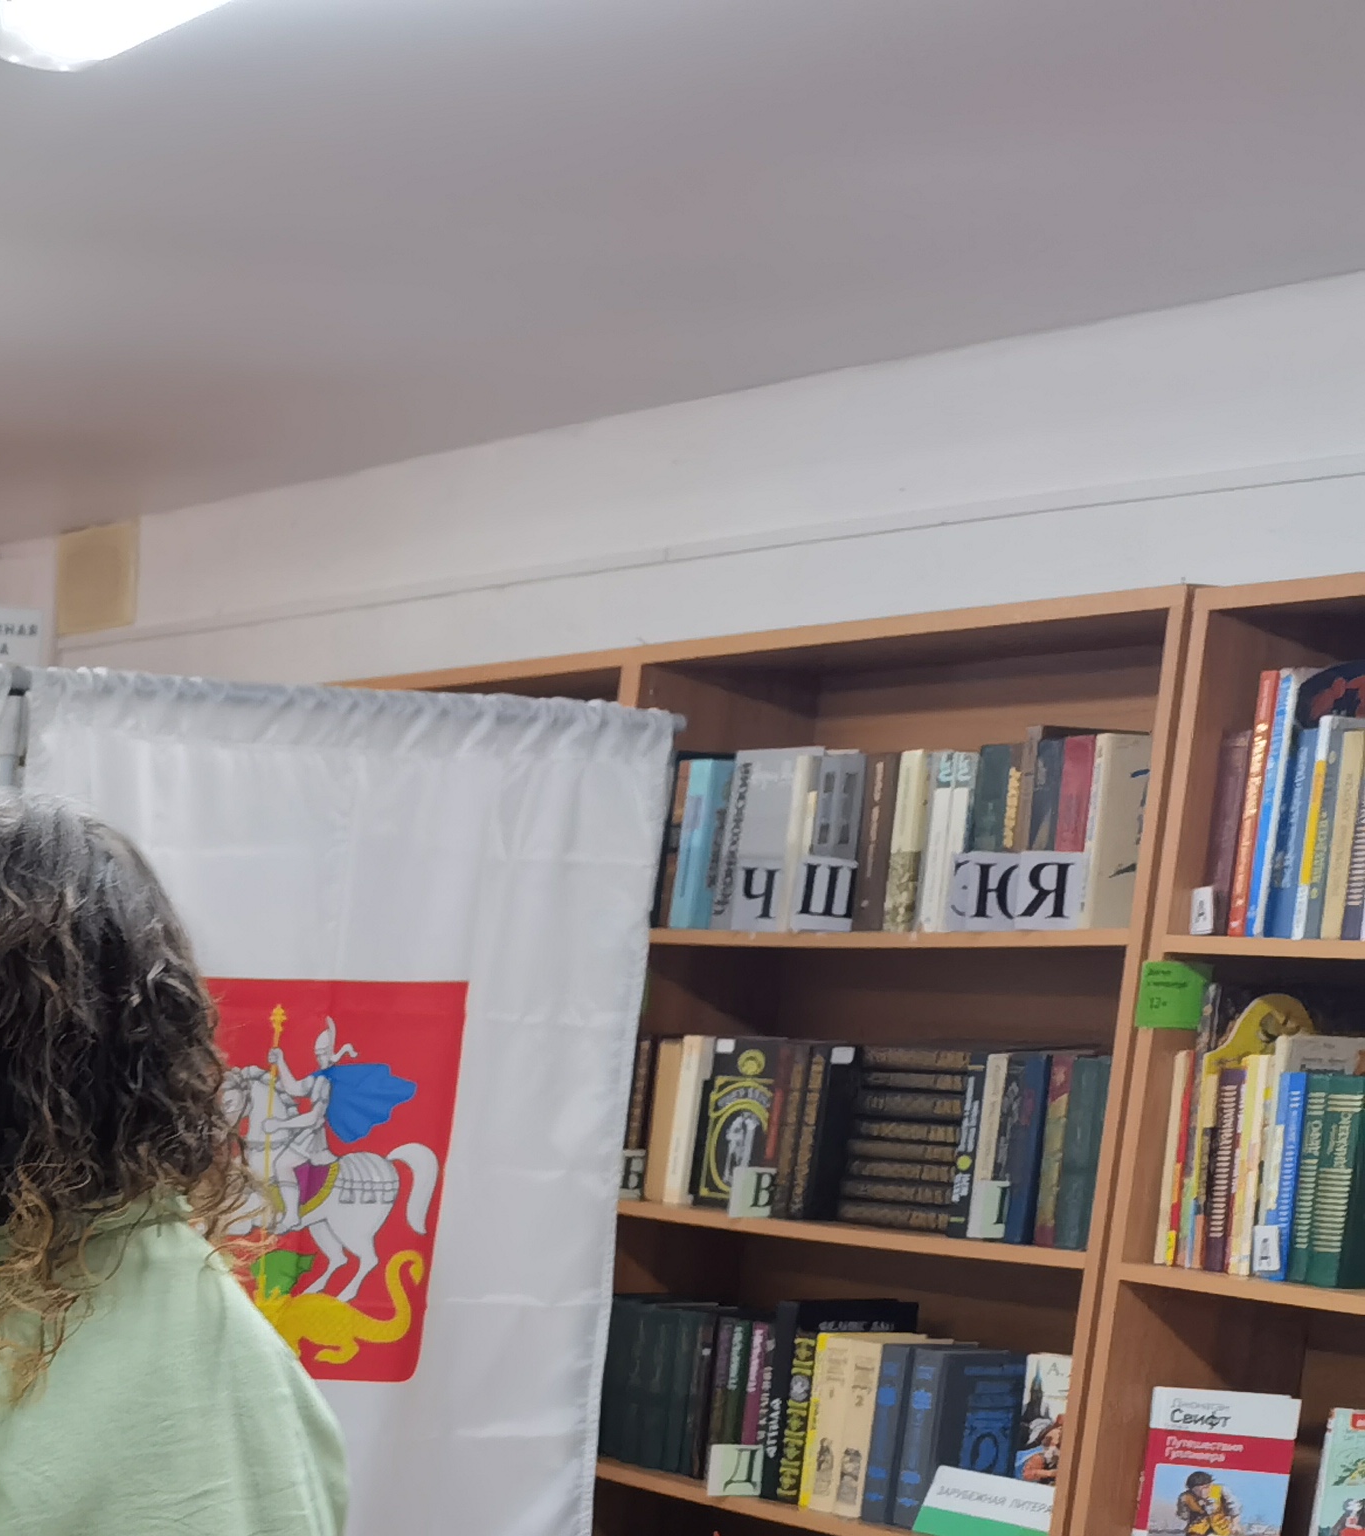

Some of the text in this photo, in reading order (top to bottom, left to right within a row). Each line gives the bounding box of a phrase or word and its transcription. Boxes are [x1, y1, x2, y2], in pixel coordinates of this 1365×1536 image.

[742, 867, 782, 919] Ч
[797, 863, 858, 918] Ш
[1019, 862, 1075, 920] Я
[750, 1172, 777, 1208] В
[1170, 1408, 1231, 1431] Свифт
[723, 1446, 761, 1493] Д
[936, 1485, 1007, 1507] ЗАРУБЕЖНАЯ
